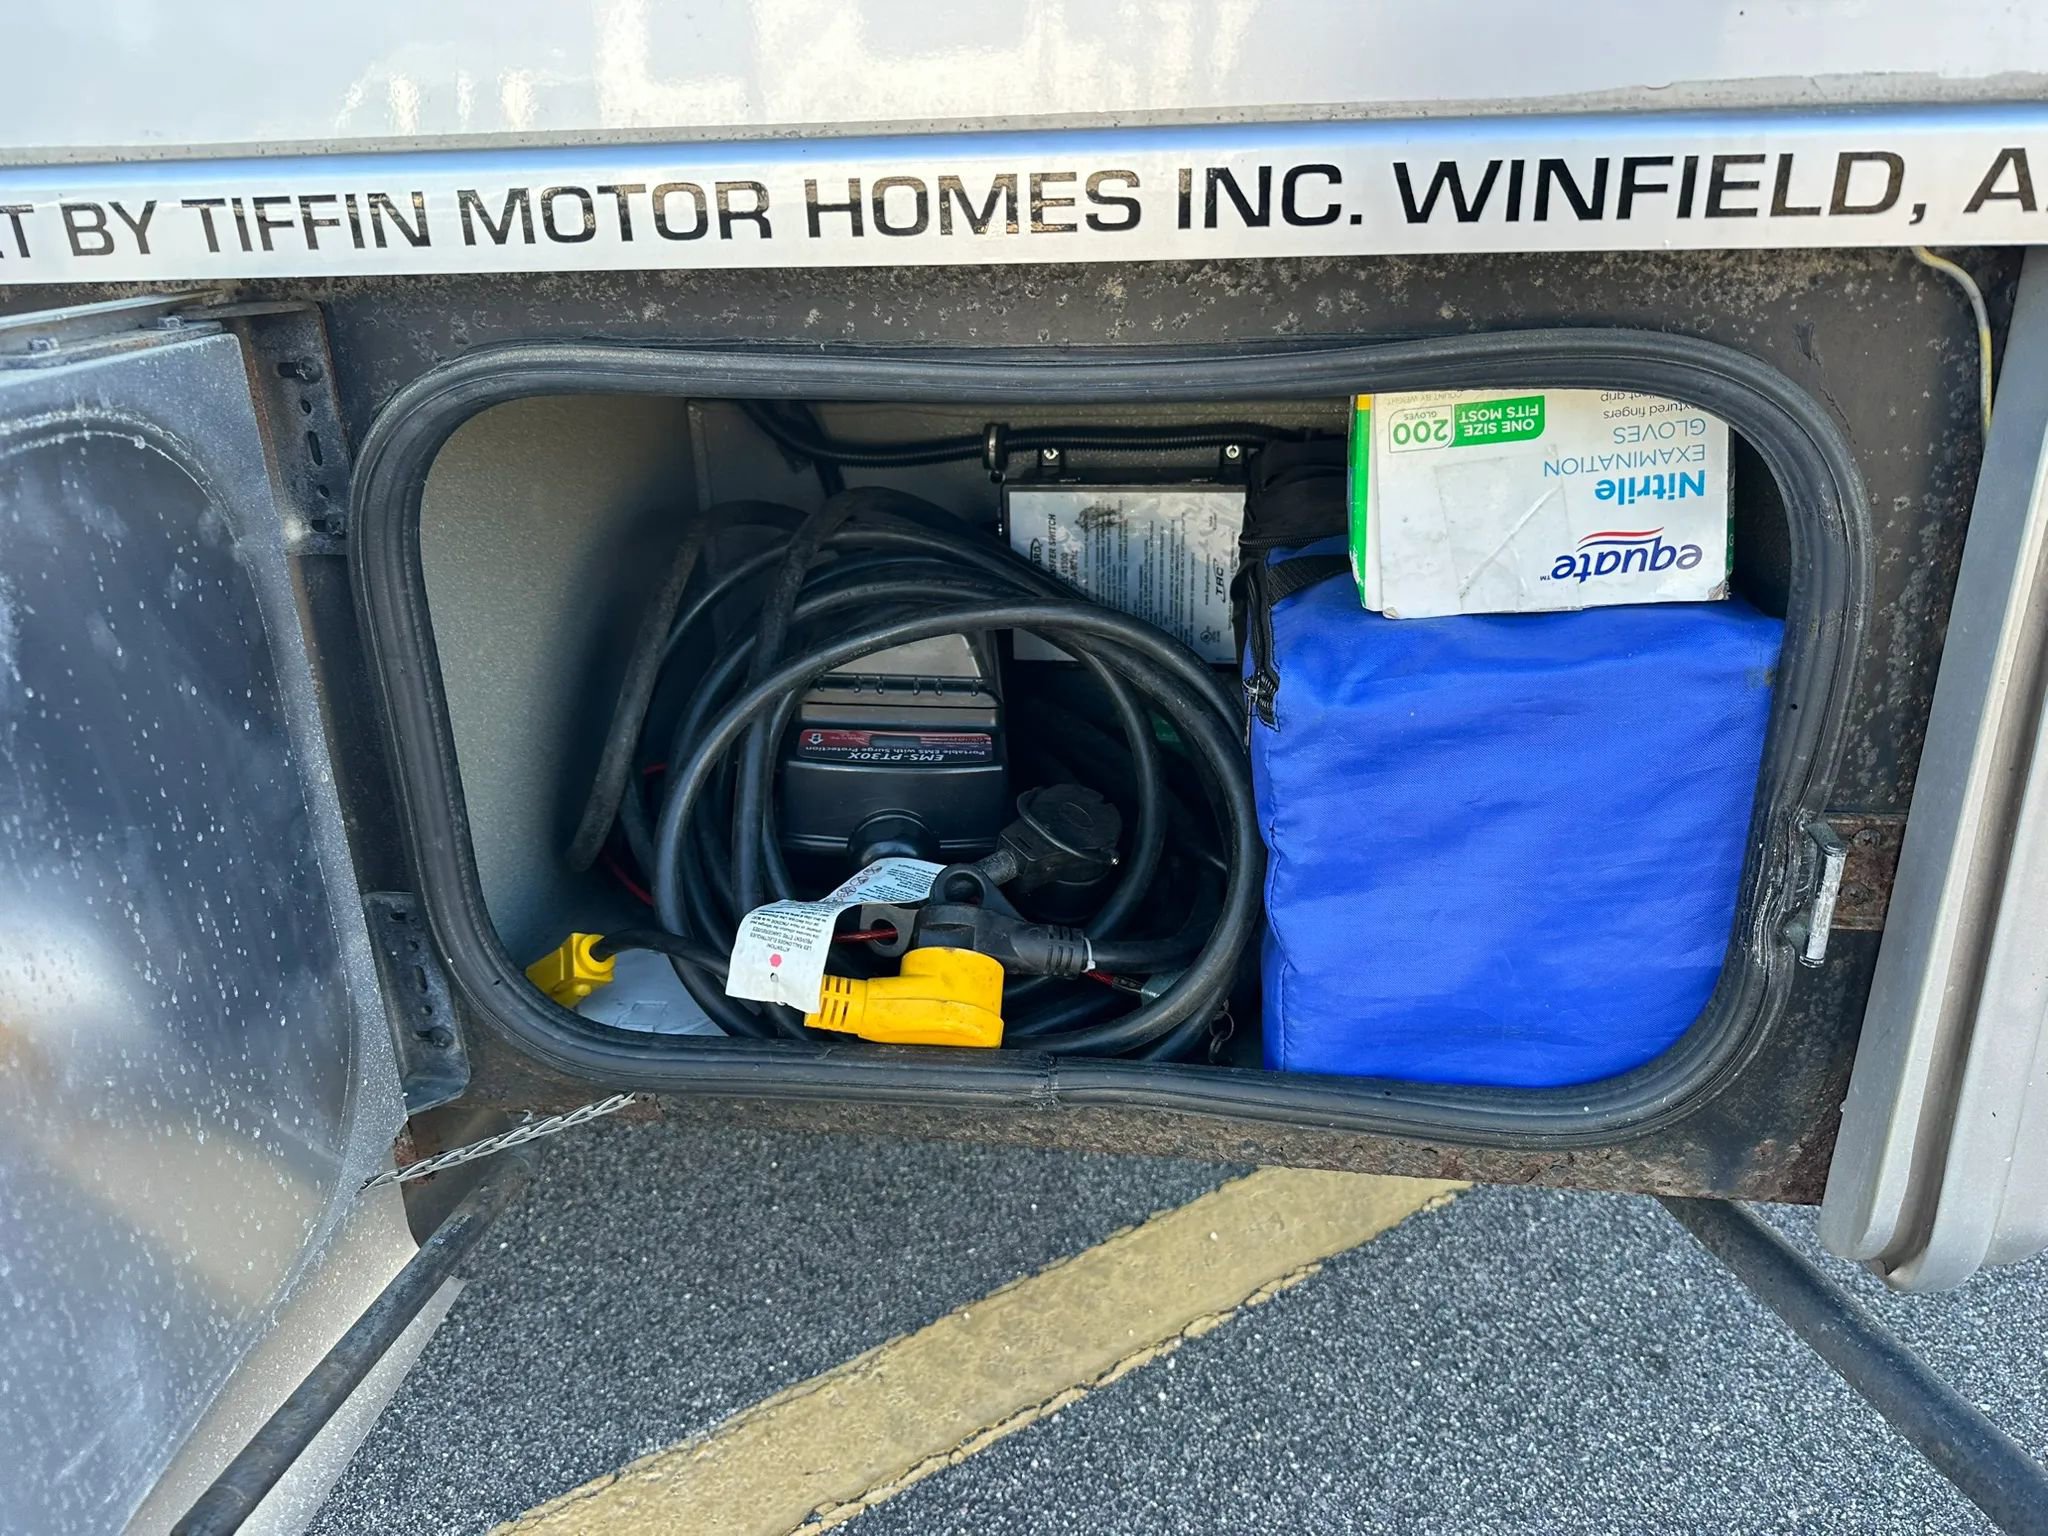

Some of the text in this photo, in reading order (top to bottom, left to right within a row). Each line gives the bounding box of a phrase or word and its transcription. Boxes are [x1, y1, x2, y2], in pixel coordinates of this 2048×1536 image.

[0, 147, 2048, 259] T BY TIFFIN MOTOR HOMES INC. WINFIELD, A
[1403, 410, 1438, 421] GLOVES
[1458, 404, 1539, 423] FITS MOST
[1603, 402, 1694, 420] xtured fingers
[1392, 419, 1449, 446] 200
[1463, 418, 1535, 437] ONE SIZE
[1612, 418, 1706, 444] GLOVES
[1543, 443, 1706, 477] EXAMINATION
[1594, 469, 1706, 505] Nitrile
[1551, 535, 1703, 584] equate
[848, 752, 944, 761] EMS-PT30X
[861, 746, 890, 754] Surge
